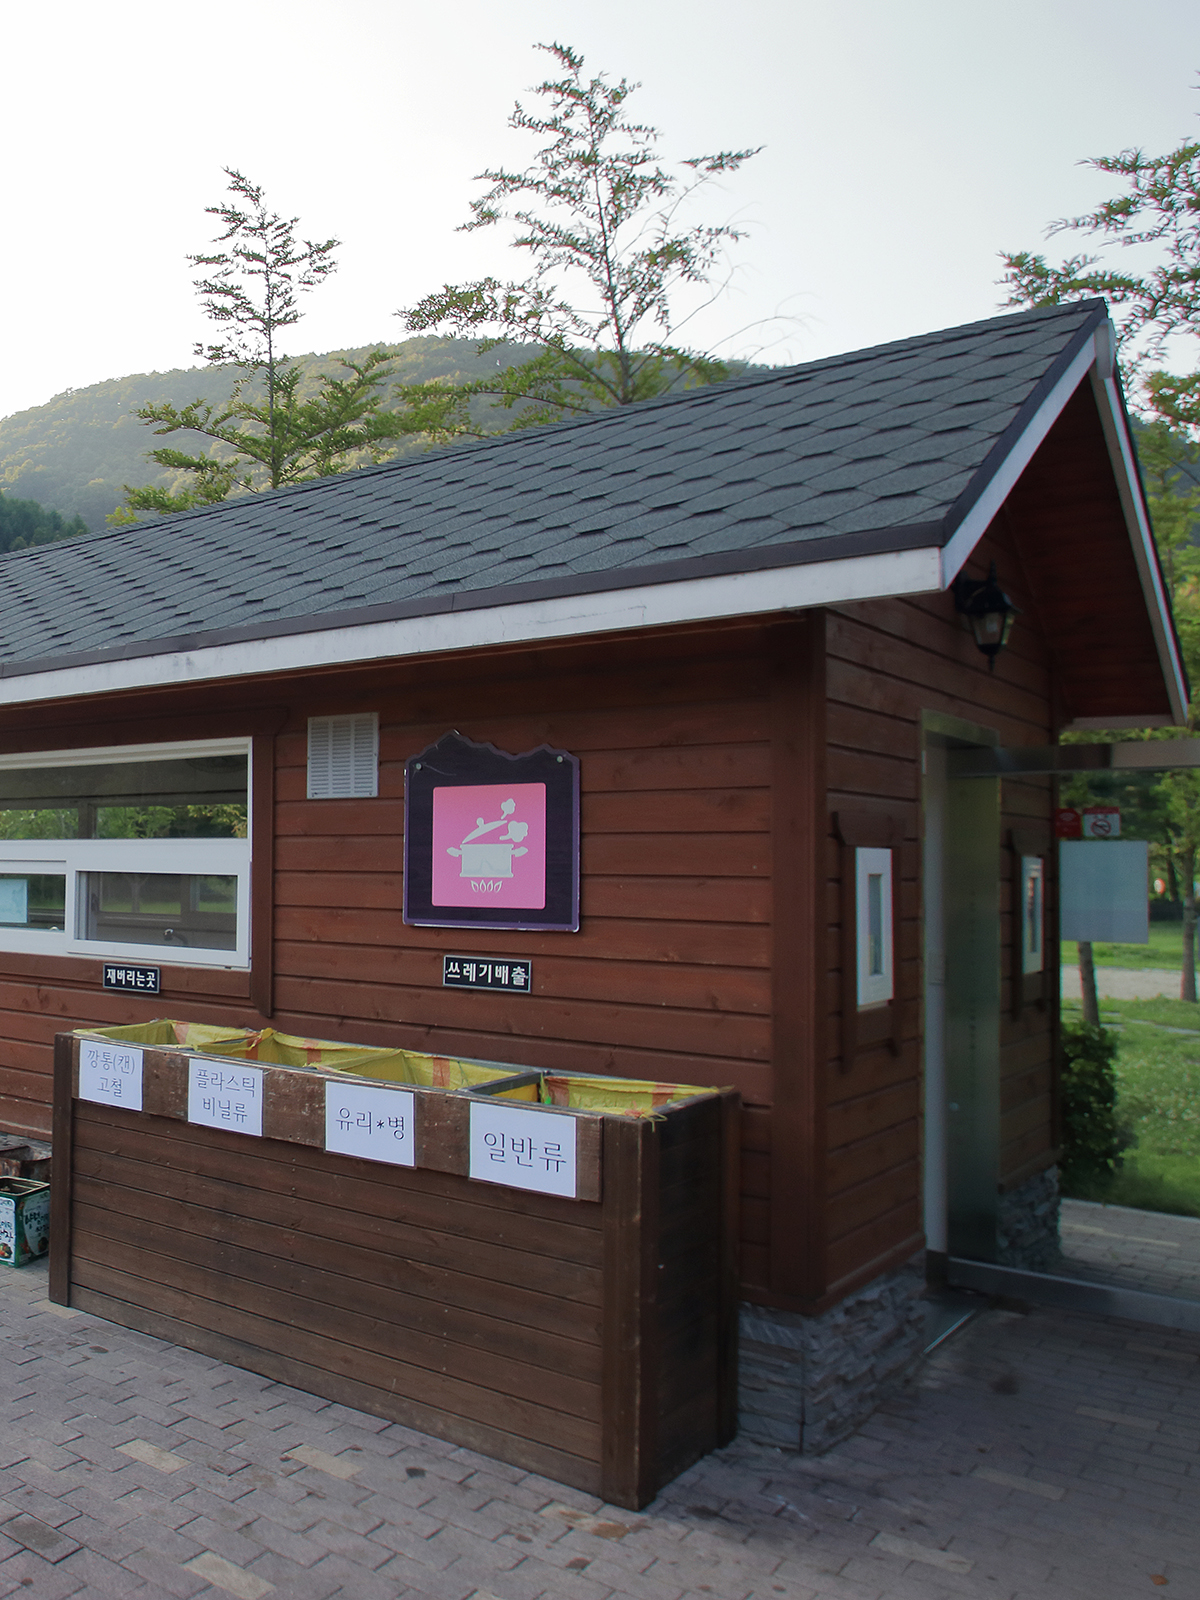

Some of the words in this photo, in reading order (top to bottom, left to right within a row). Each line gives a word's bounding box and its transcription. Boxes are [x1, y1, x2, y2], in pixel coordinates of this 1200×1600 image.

[106, 968, 156, 988] 재버리는곳
[446, 961, 527, 986] 쓰레기배출
[86, 1049, 136, 1075] 깡통(캔)
[97, 1076, 123, 1098] 고철
[195, 1068, 256, 1098] 플라스틱
[202, 1096, 248, 1124] 비닐류
[483, 1132, 567, 1173] 일반류
